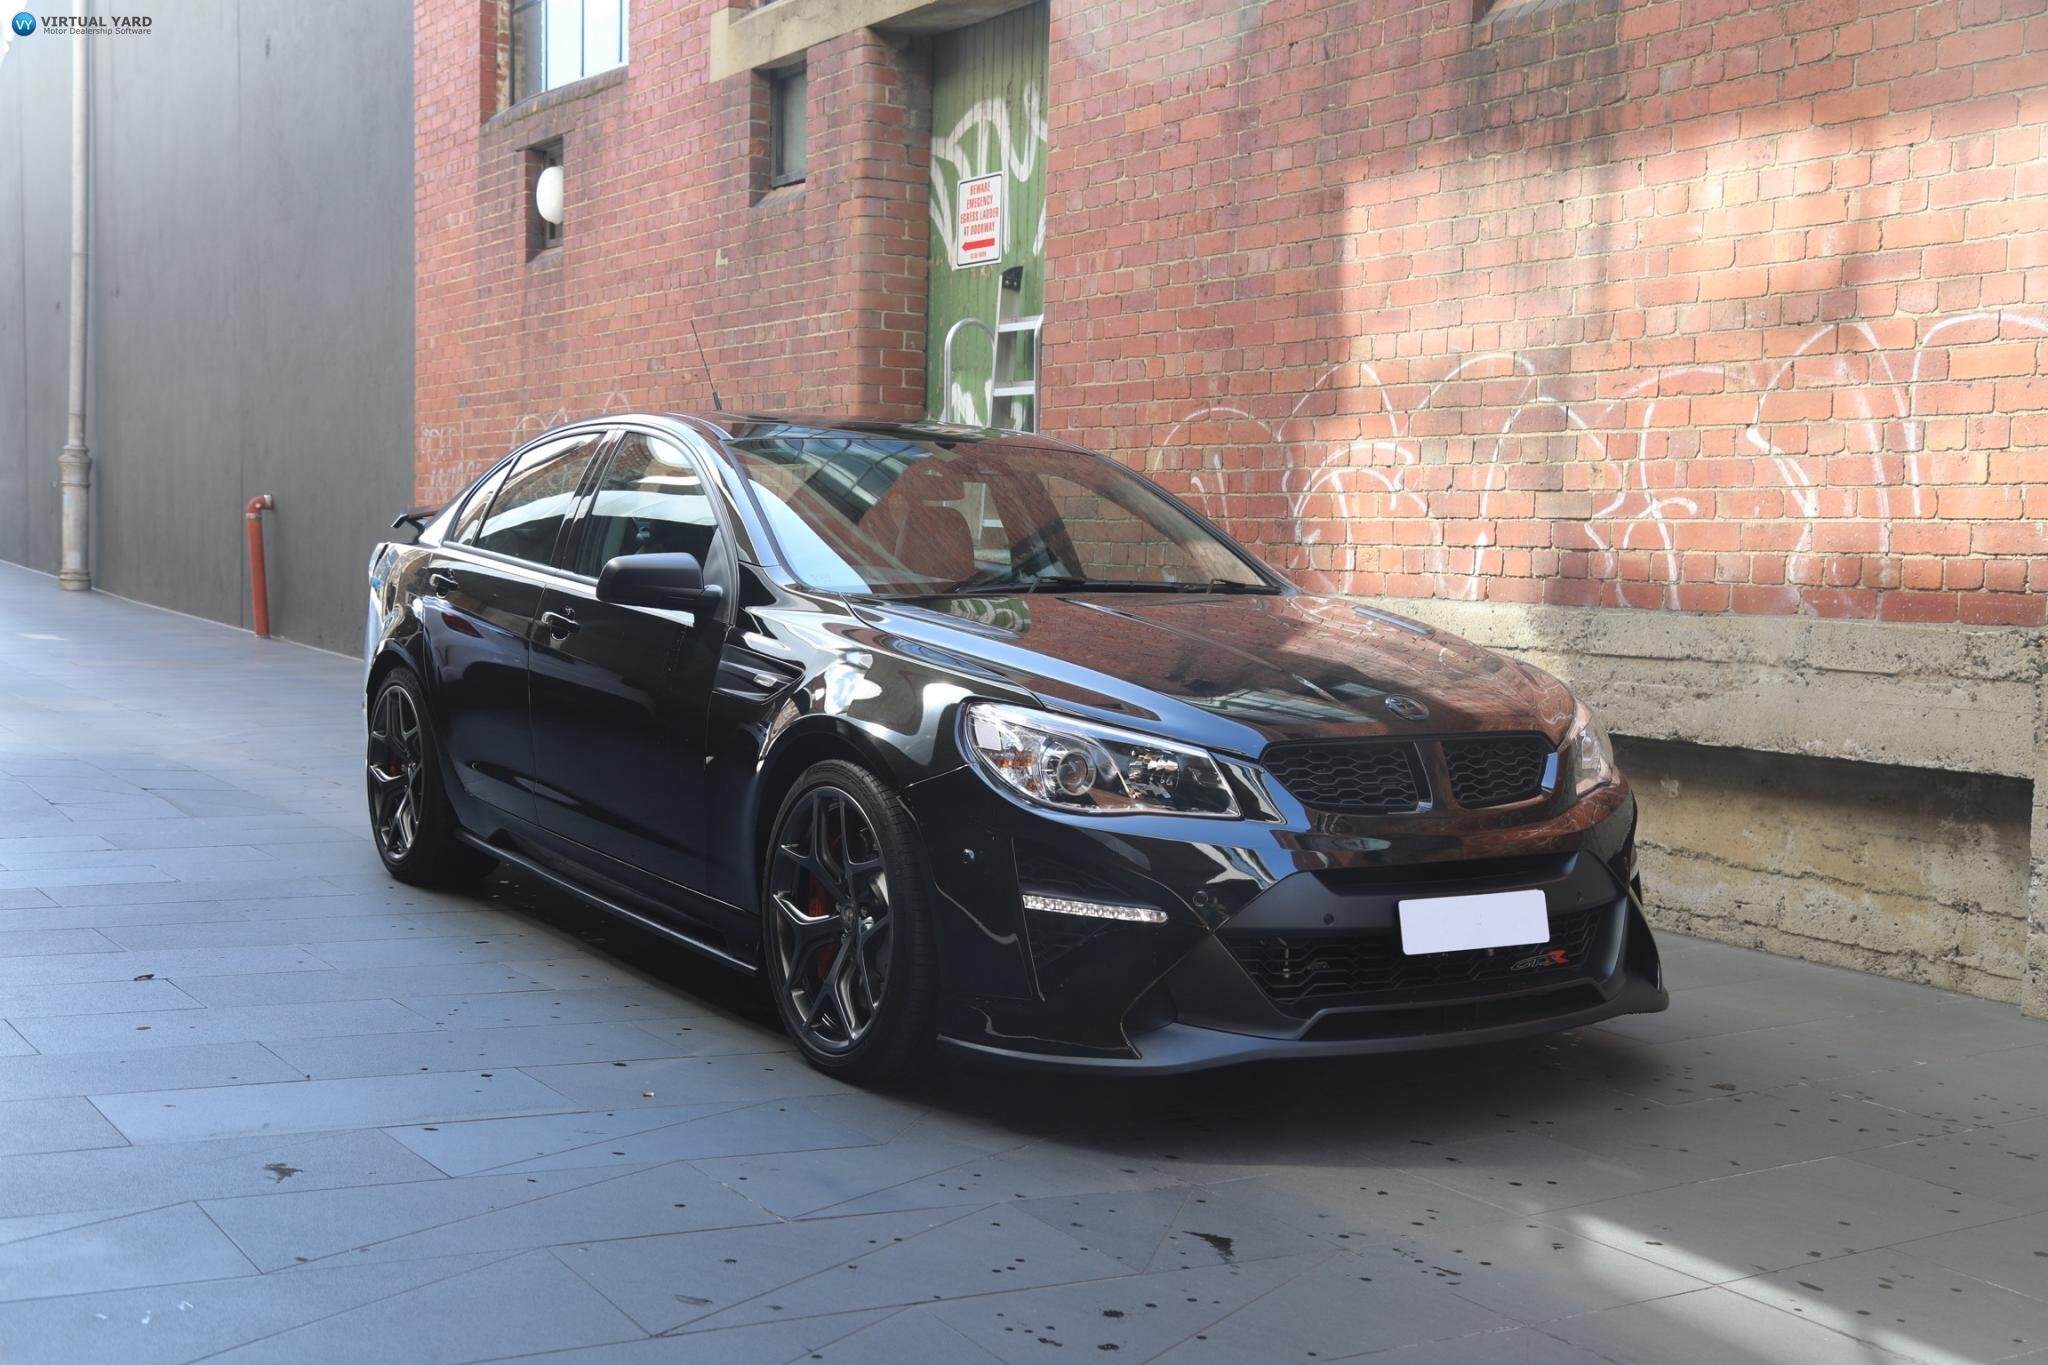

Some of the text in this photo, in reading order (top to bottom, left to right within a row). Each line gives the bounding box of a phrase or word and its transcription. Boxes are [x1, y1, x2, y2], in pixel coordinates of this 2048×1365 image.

[970, 182, 990, 196] BEWARE
[960, 207, 999, 224] EGRESS LADDER
[964, 222, 995, 236] AT DOORWAY
